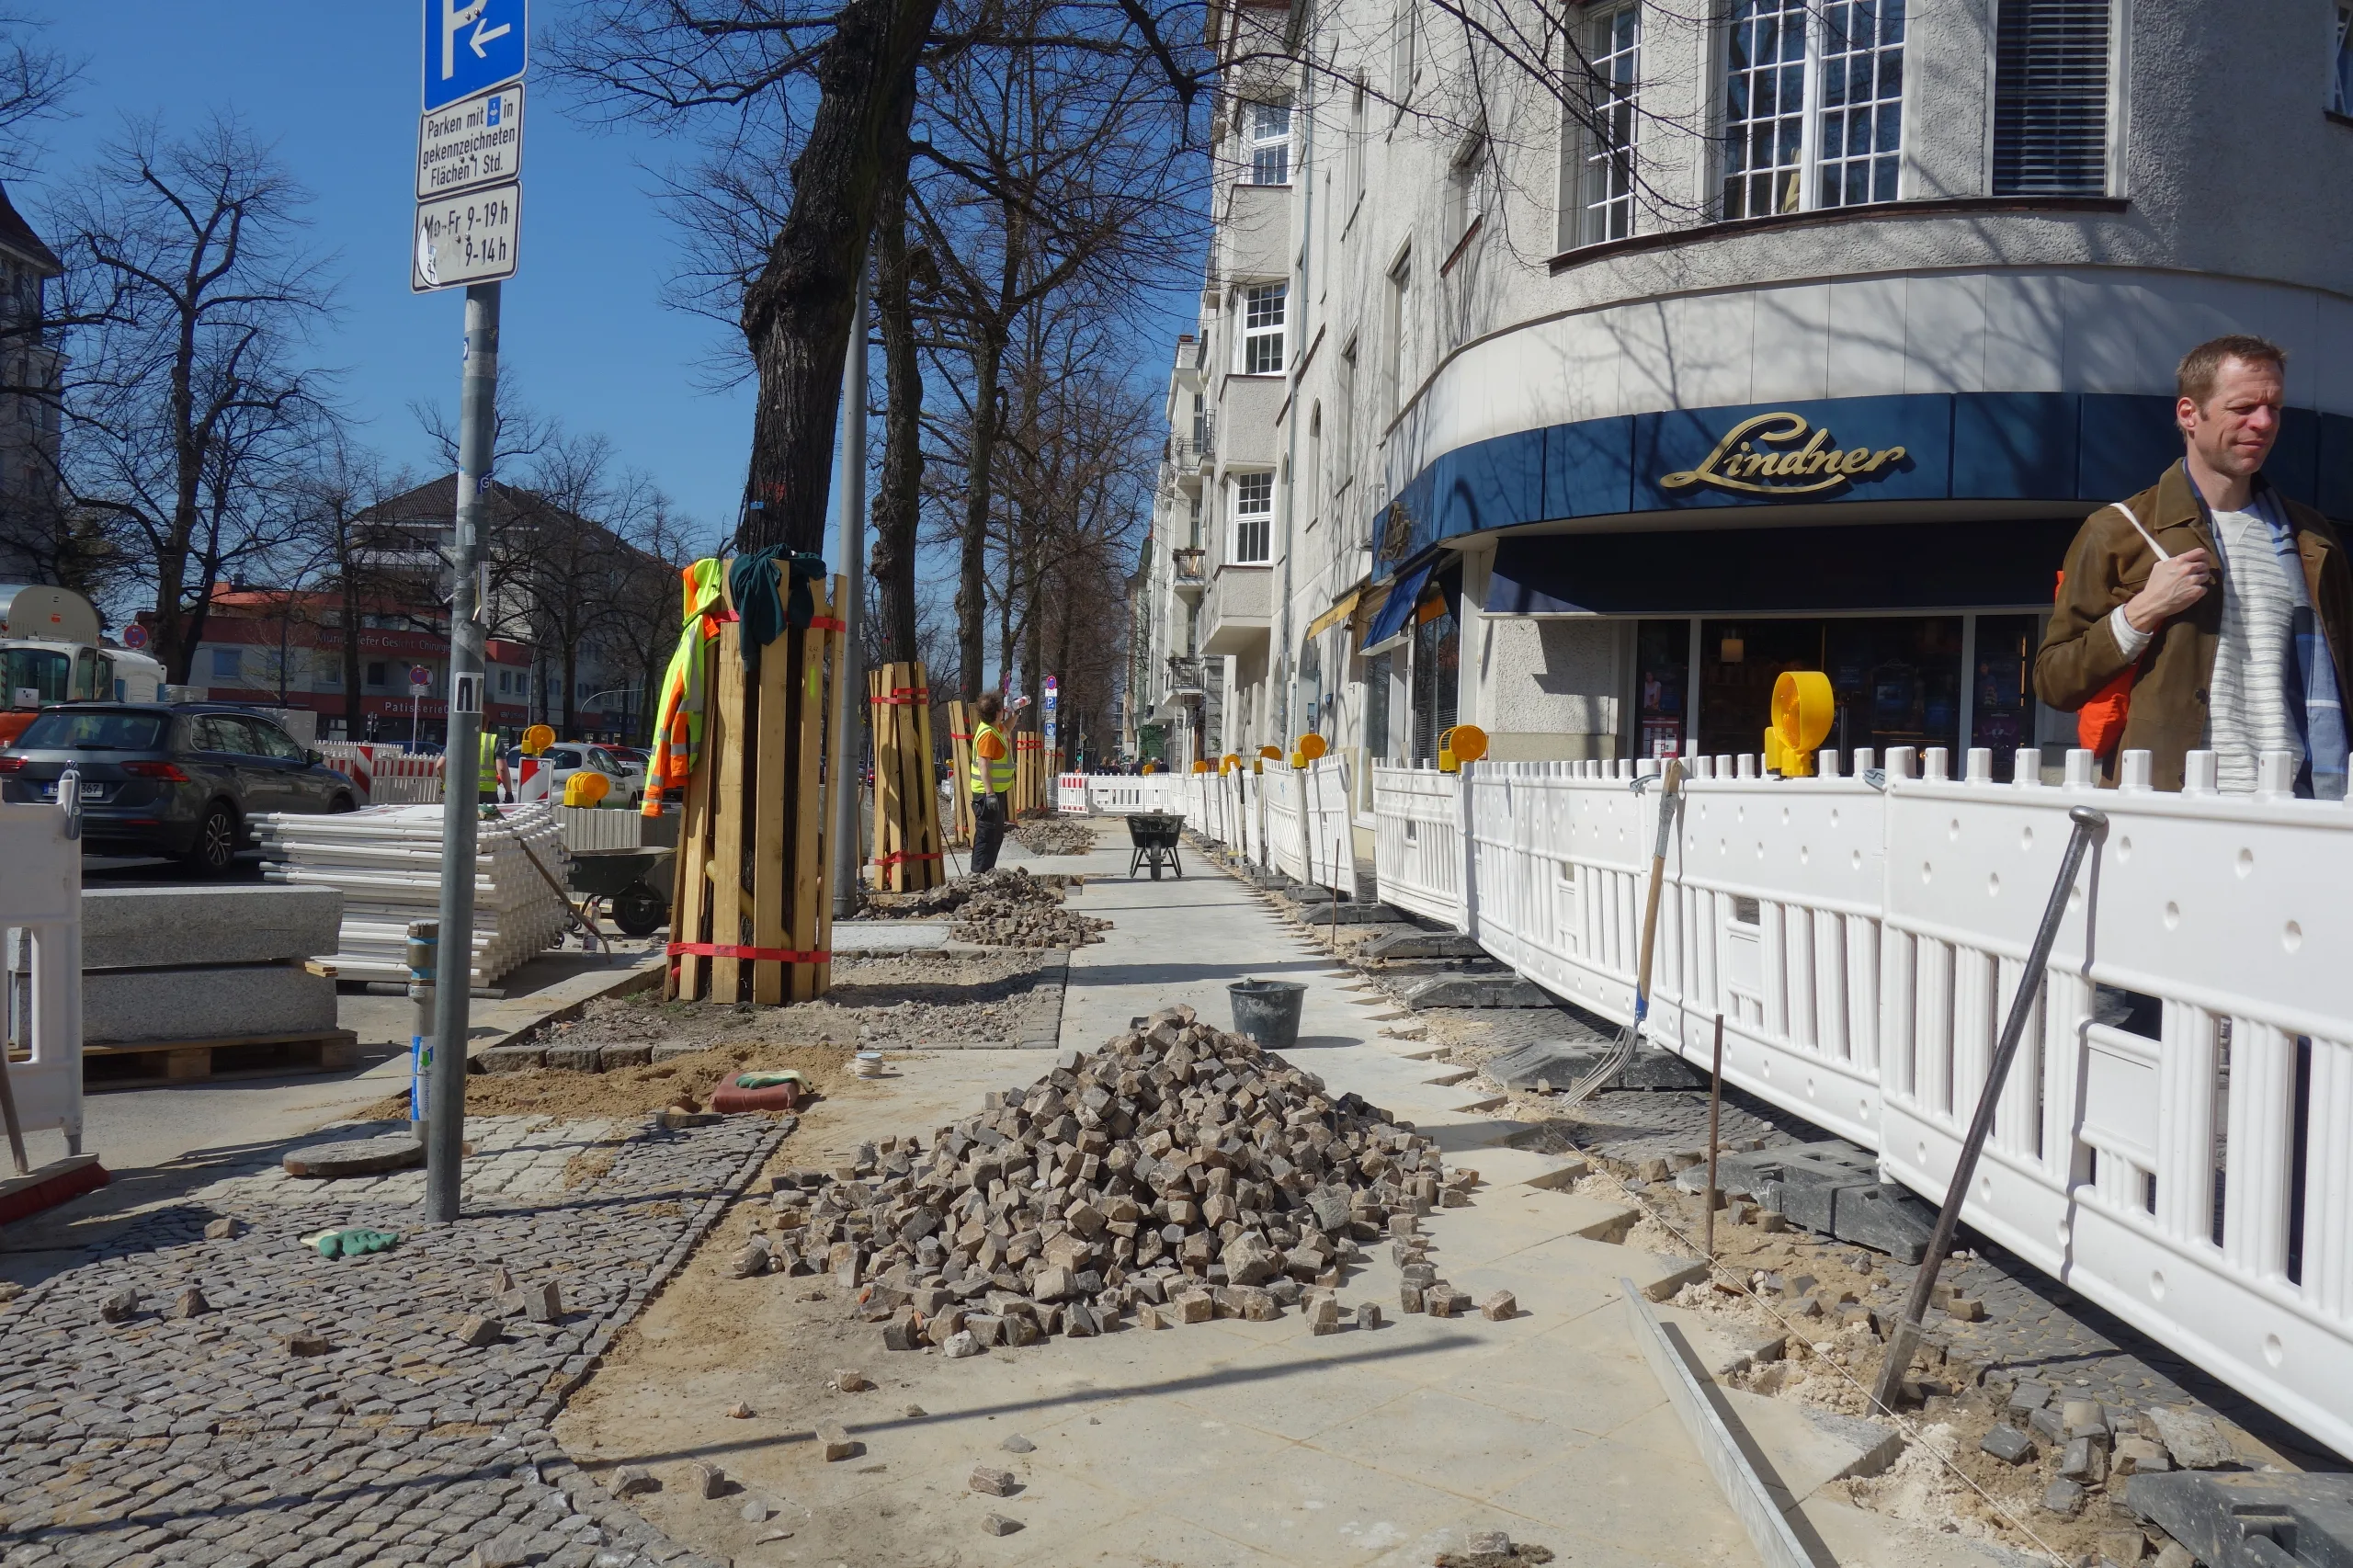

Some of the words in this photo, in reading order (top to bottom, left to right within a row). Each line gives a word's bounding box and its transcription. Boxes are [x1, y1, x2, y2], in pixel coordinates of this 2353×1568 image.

[427, 116, 461, 140] Parken
[467, 107, 484, 129] mit
[503, 99, 514, 119] in
[423, 127, 515, 170] gekennzeichneten
[430, 162, 470, 187] Flächen
[473, 157, 478, 176] 1
[483, 152, 504, 175] Std.
[1659, 411, 1906, 494] Lindner
[356, 633, 380, 646] iefer
[381, 636, 415, 649] Gesicht
[418, 639, 451, 654] Chirurgie
